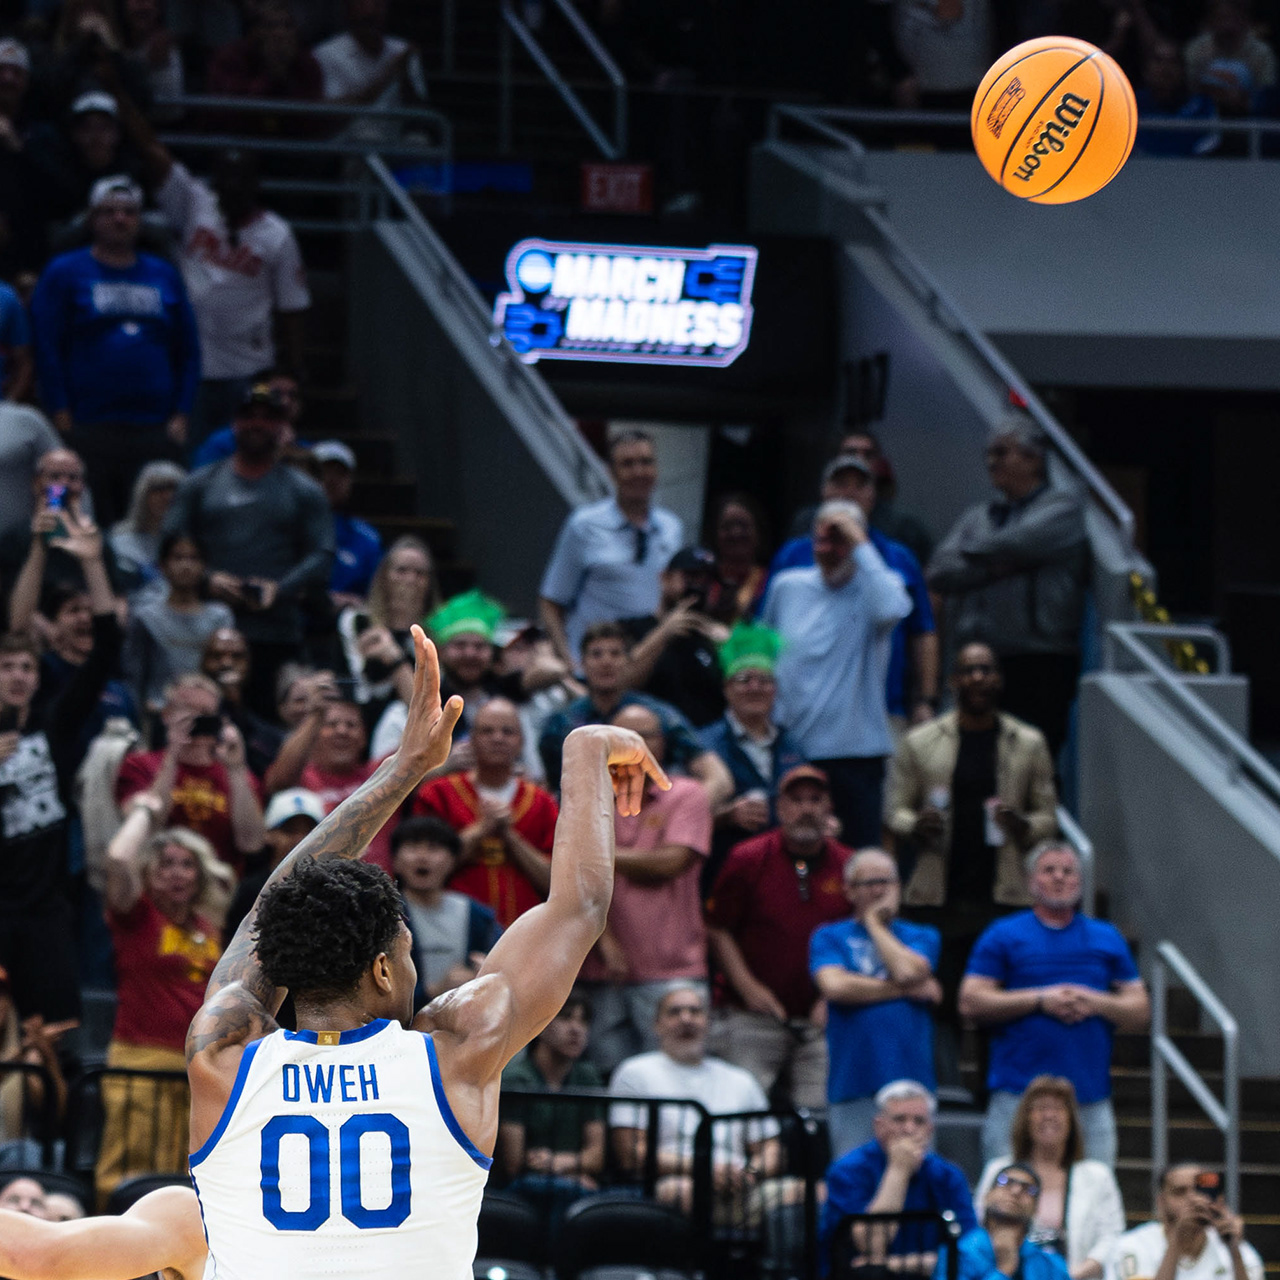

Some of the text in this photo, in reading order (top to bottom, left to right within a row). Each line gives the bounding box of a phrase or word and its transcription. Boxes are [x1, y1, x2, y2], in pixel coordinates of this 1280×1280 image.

[1013, 92, 1090, 182] Wilson
[549, 253, 686, 303] MARCH
[565, 299, 745, 347] MADNESS
[282, 1063, 380, 1103] OWEH
[259, 1112, 412, 1232] 00
